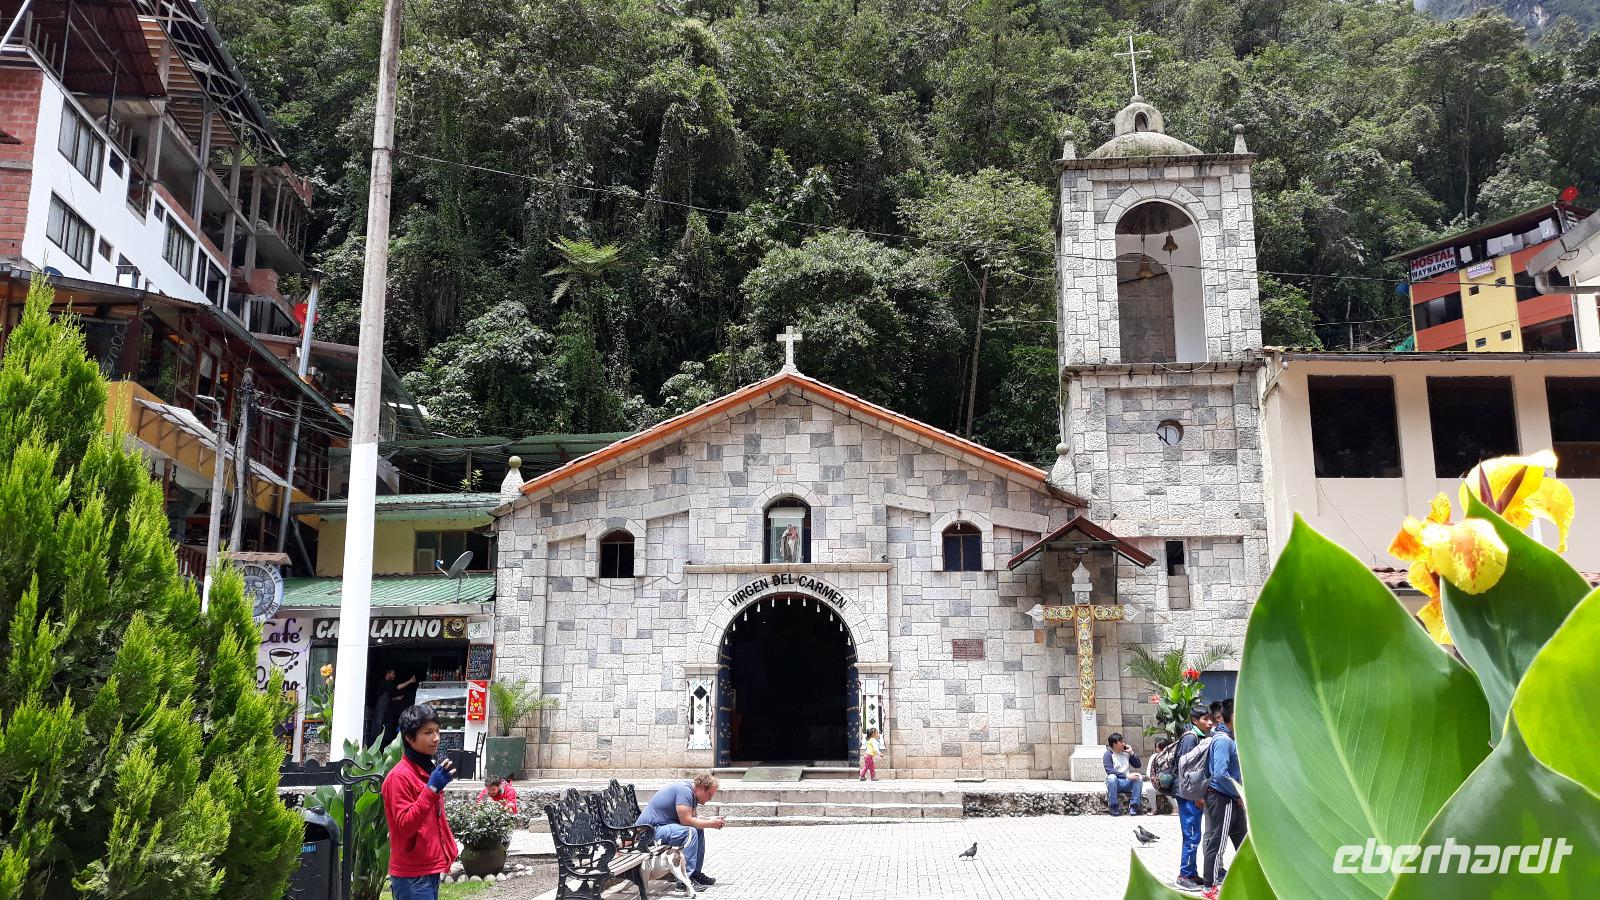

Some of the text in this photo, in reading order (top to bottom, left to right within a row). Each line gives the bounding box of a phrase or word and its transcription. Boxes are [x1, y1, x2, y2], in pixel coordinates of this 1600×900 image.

[1411, 249, 1454, 269] HOSTAL
[1411, 259, 1456, 278] WAYNAPATA
[728, 573, 848, 609] VIRGEN DEL CARMEN
[315, 618, 442, 639] CA LATINO
